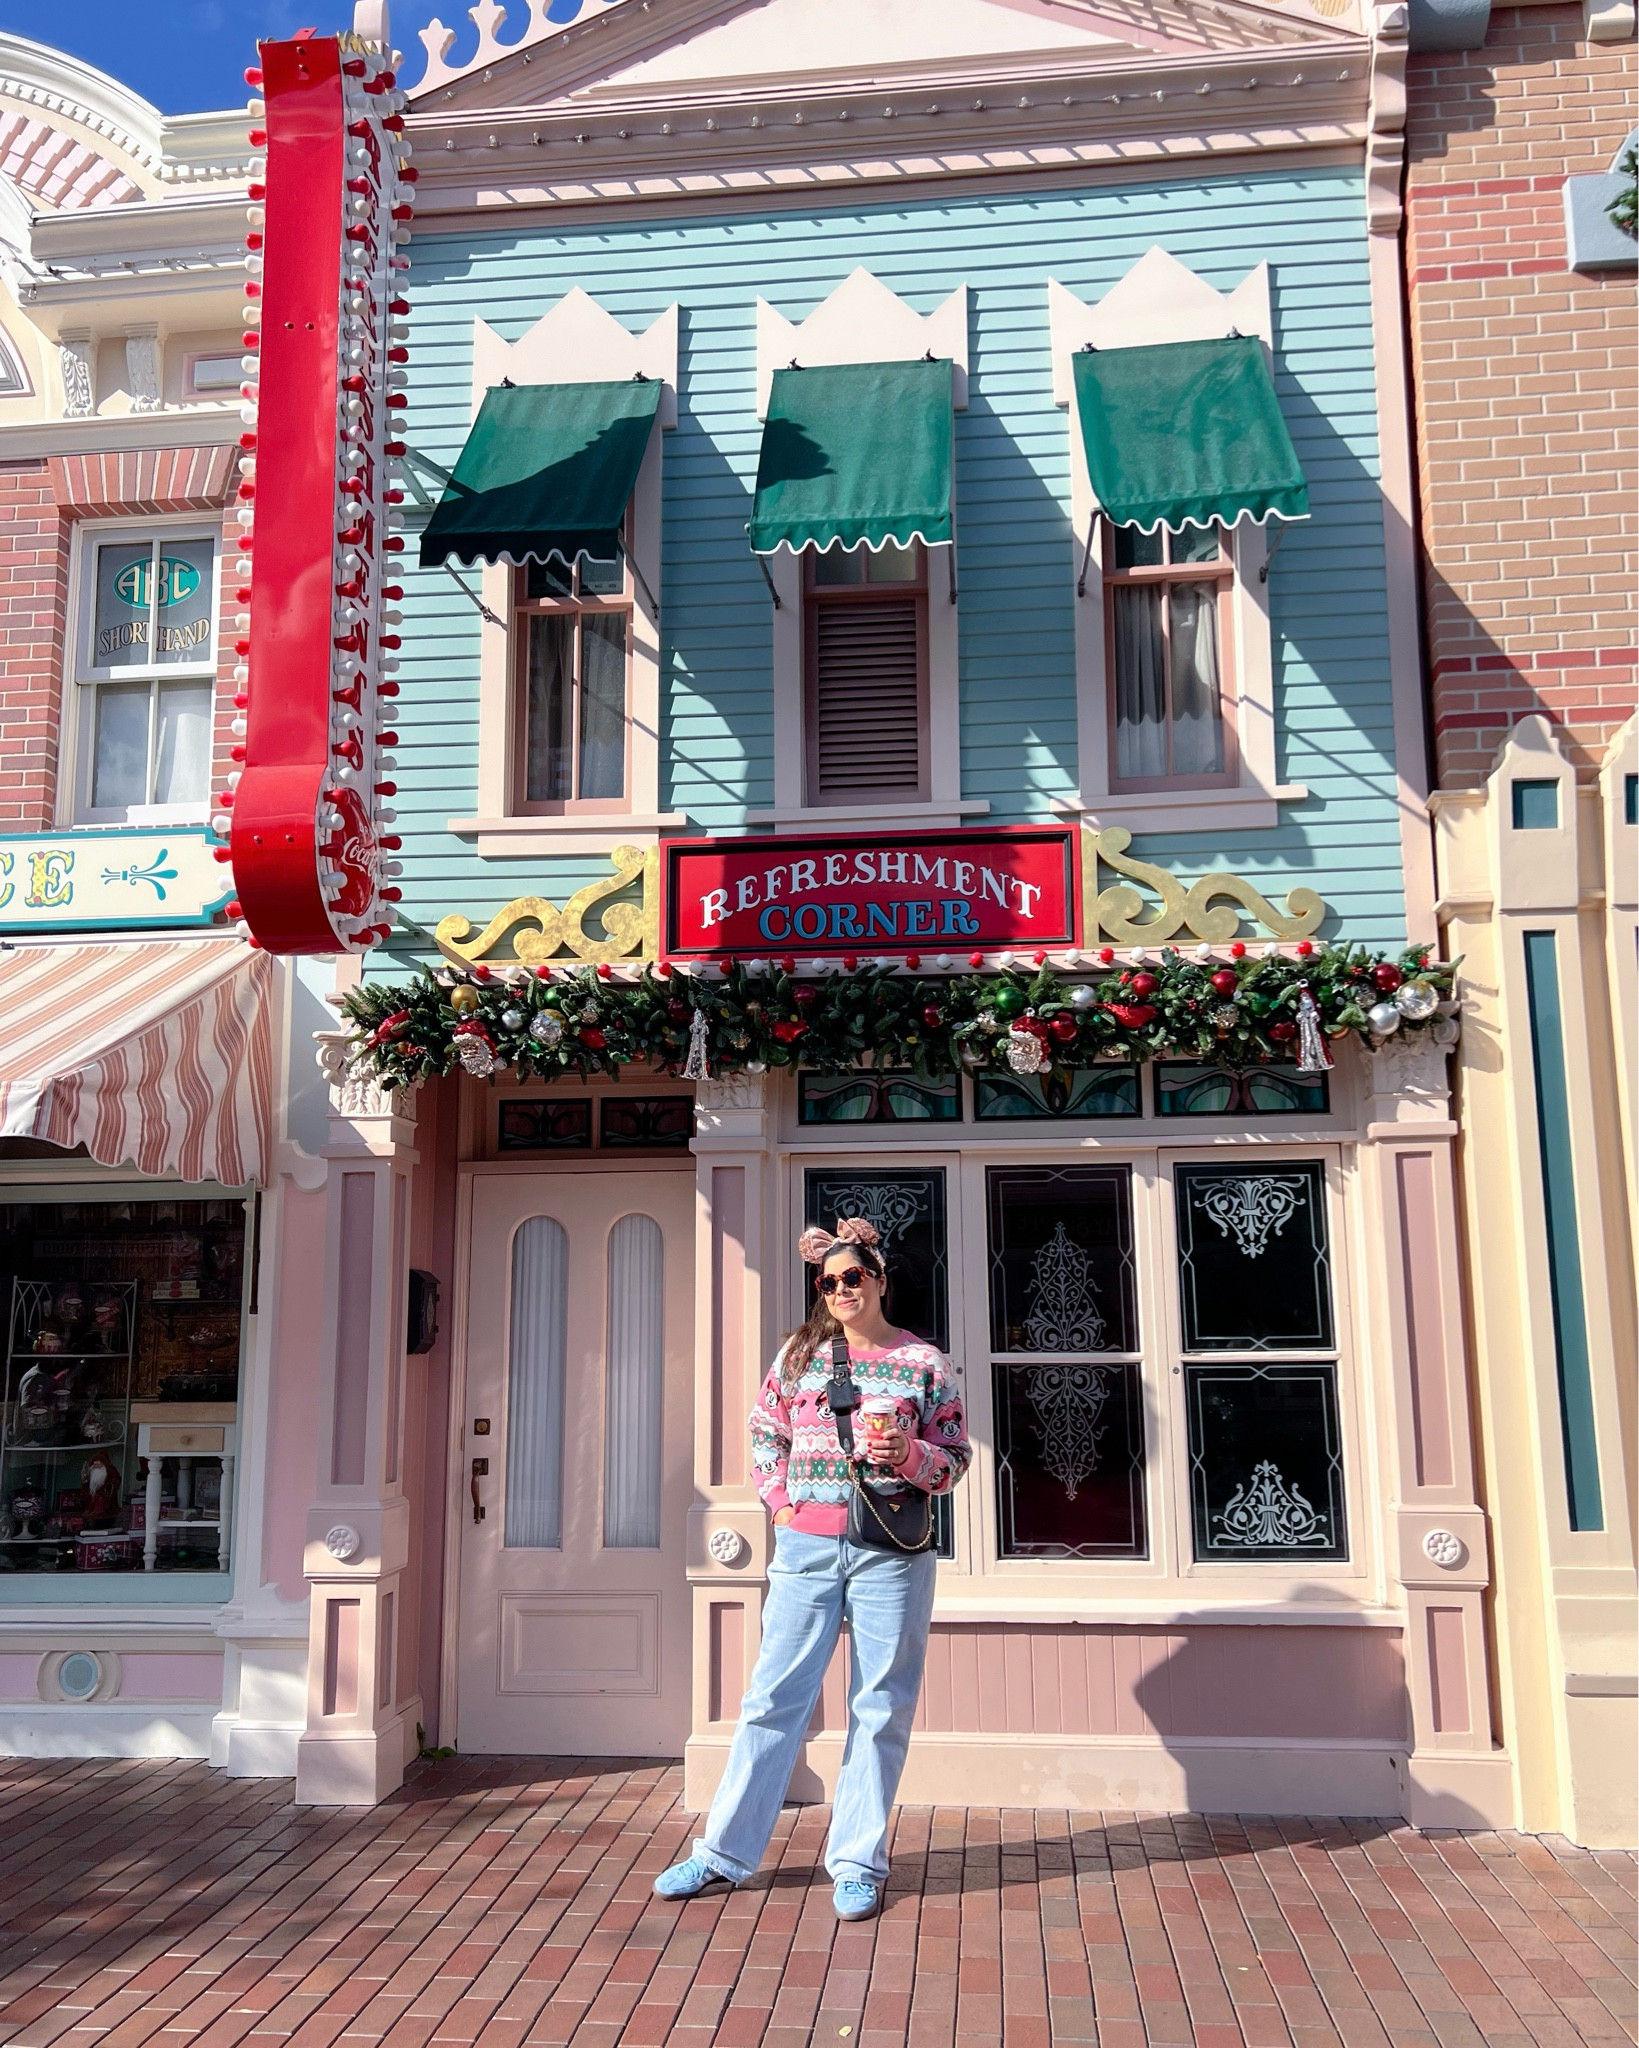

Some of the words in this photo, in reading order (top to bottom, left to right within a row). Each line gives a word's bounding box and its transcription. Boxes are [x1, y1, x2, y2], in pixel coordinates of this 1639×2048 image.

[116, 560, 192, 606] ABC
[699, 851, 1042, 930] REFRESHMENT
[758, 899, 980, 942] CORNER
